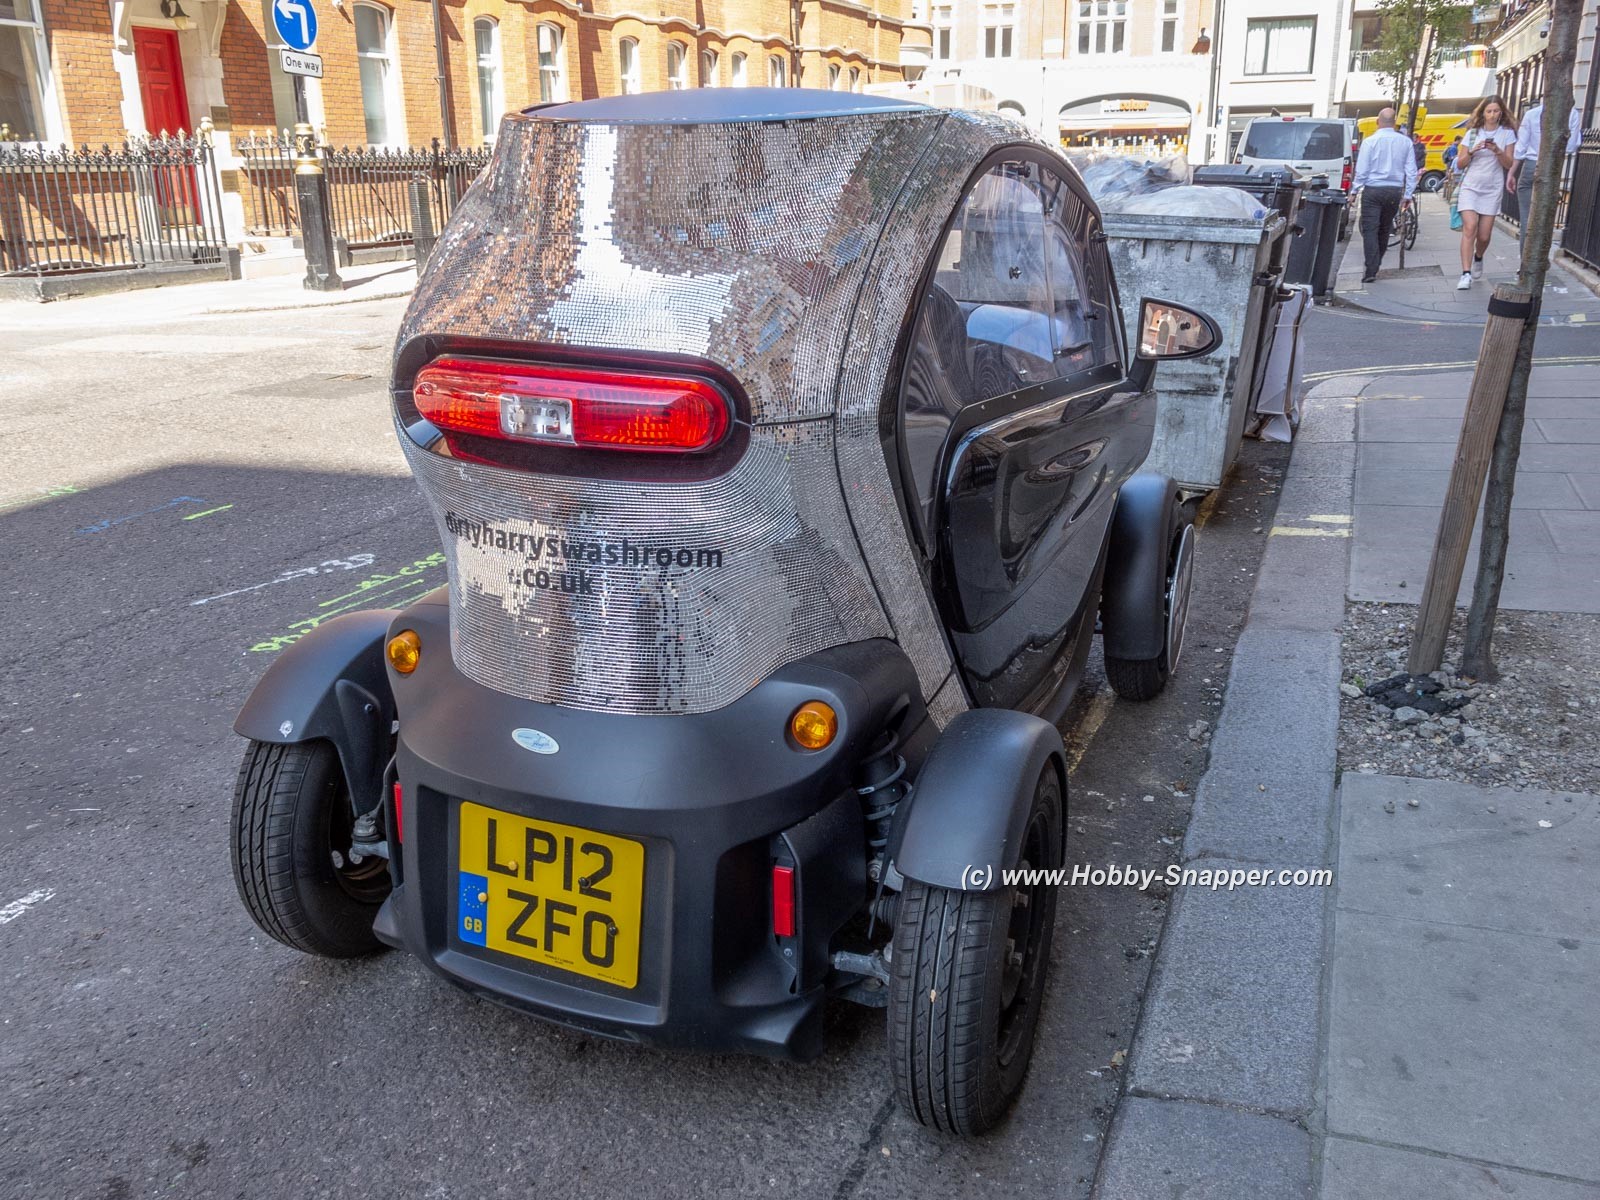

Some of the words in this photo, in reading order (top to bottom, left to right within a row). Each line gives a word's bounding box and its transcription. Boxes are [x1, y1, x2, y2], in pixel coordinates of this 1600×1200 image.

[285, 56, 302, 69] One
[304, 61, 320, 73] way
[1417, 134, 1448, 147] HL
[445, 511, 722, 568] dirtyharryswashroom
[487, 817, 614, 902] LP12
[463, 916, 482, 933] GB
